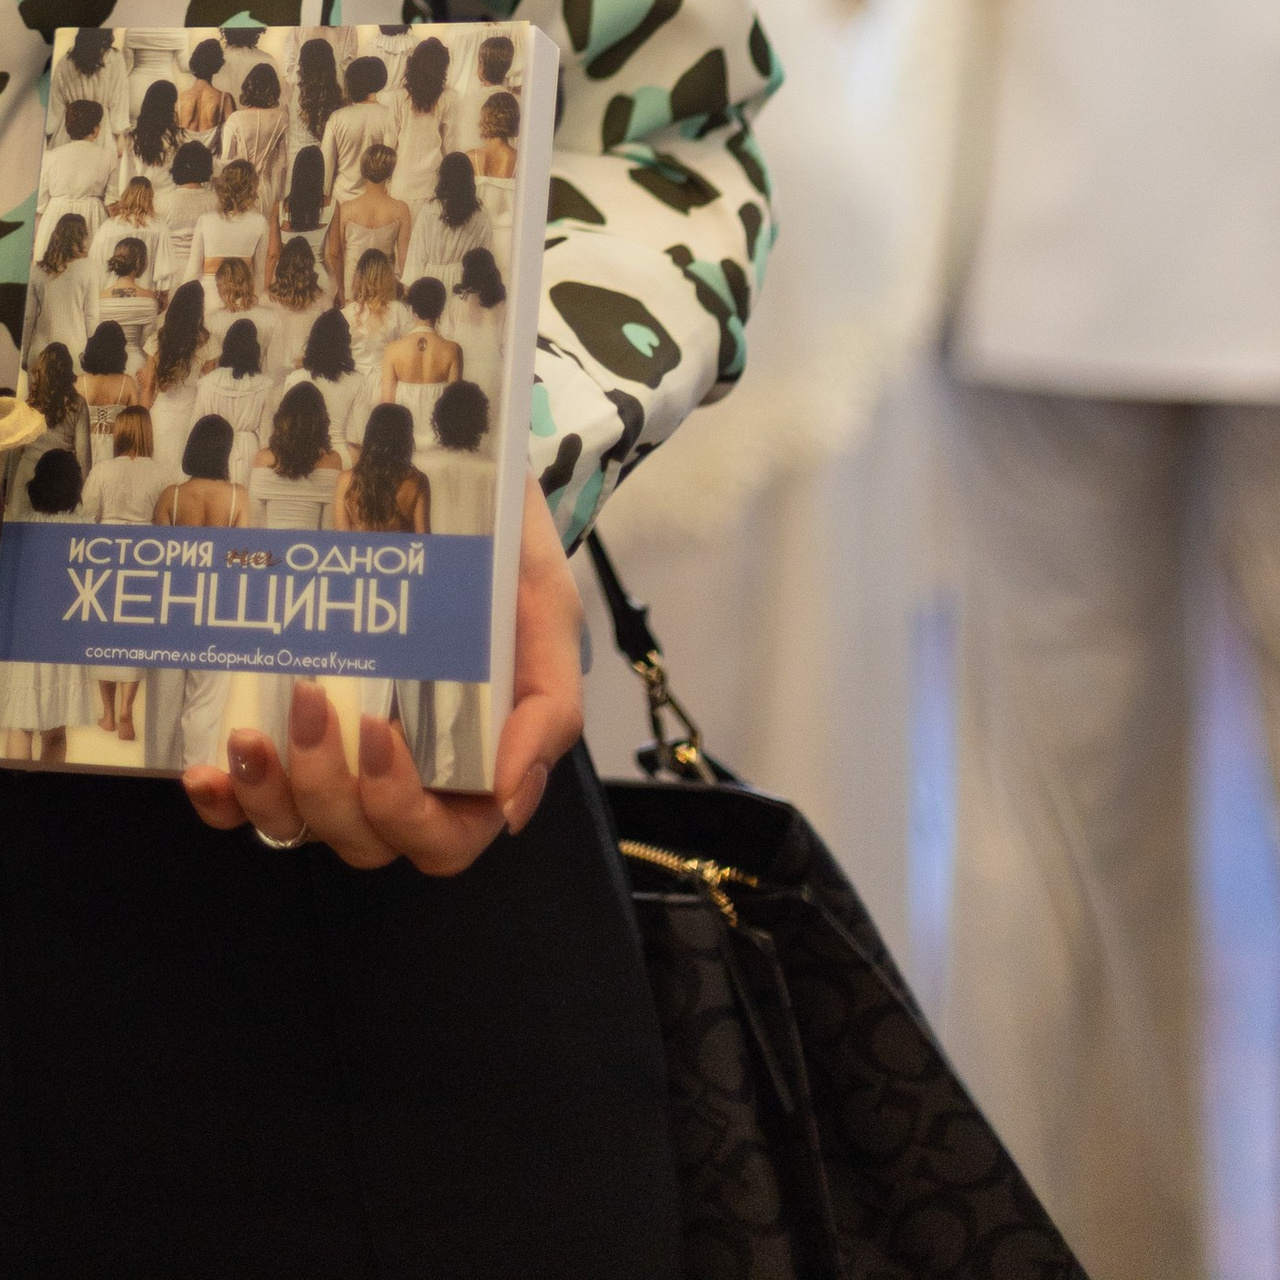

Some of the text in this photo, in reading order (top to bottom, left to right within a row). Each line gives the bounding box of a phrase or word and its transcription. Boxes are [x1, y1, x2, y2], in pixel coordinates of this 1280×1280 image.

[69, 537, 213, 567] ИСТОРИЯ
[286, 542, 425, 576] ОДНОЙ
[62, 568, 409, 635] ЖЕНЩИНЫ
[85, 645, 376, 674] составитель сборника Олеся Кунис
